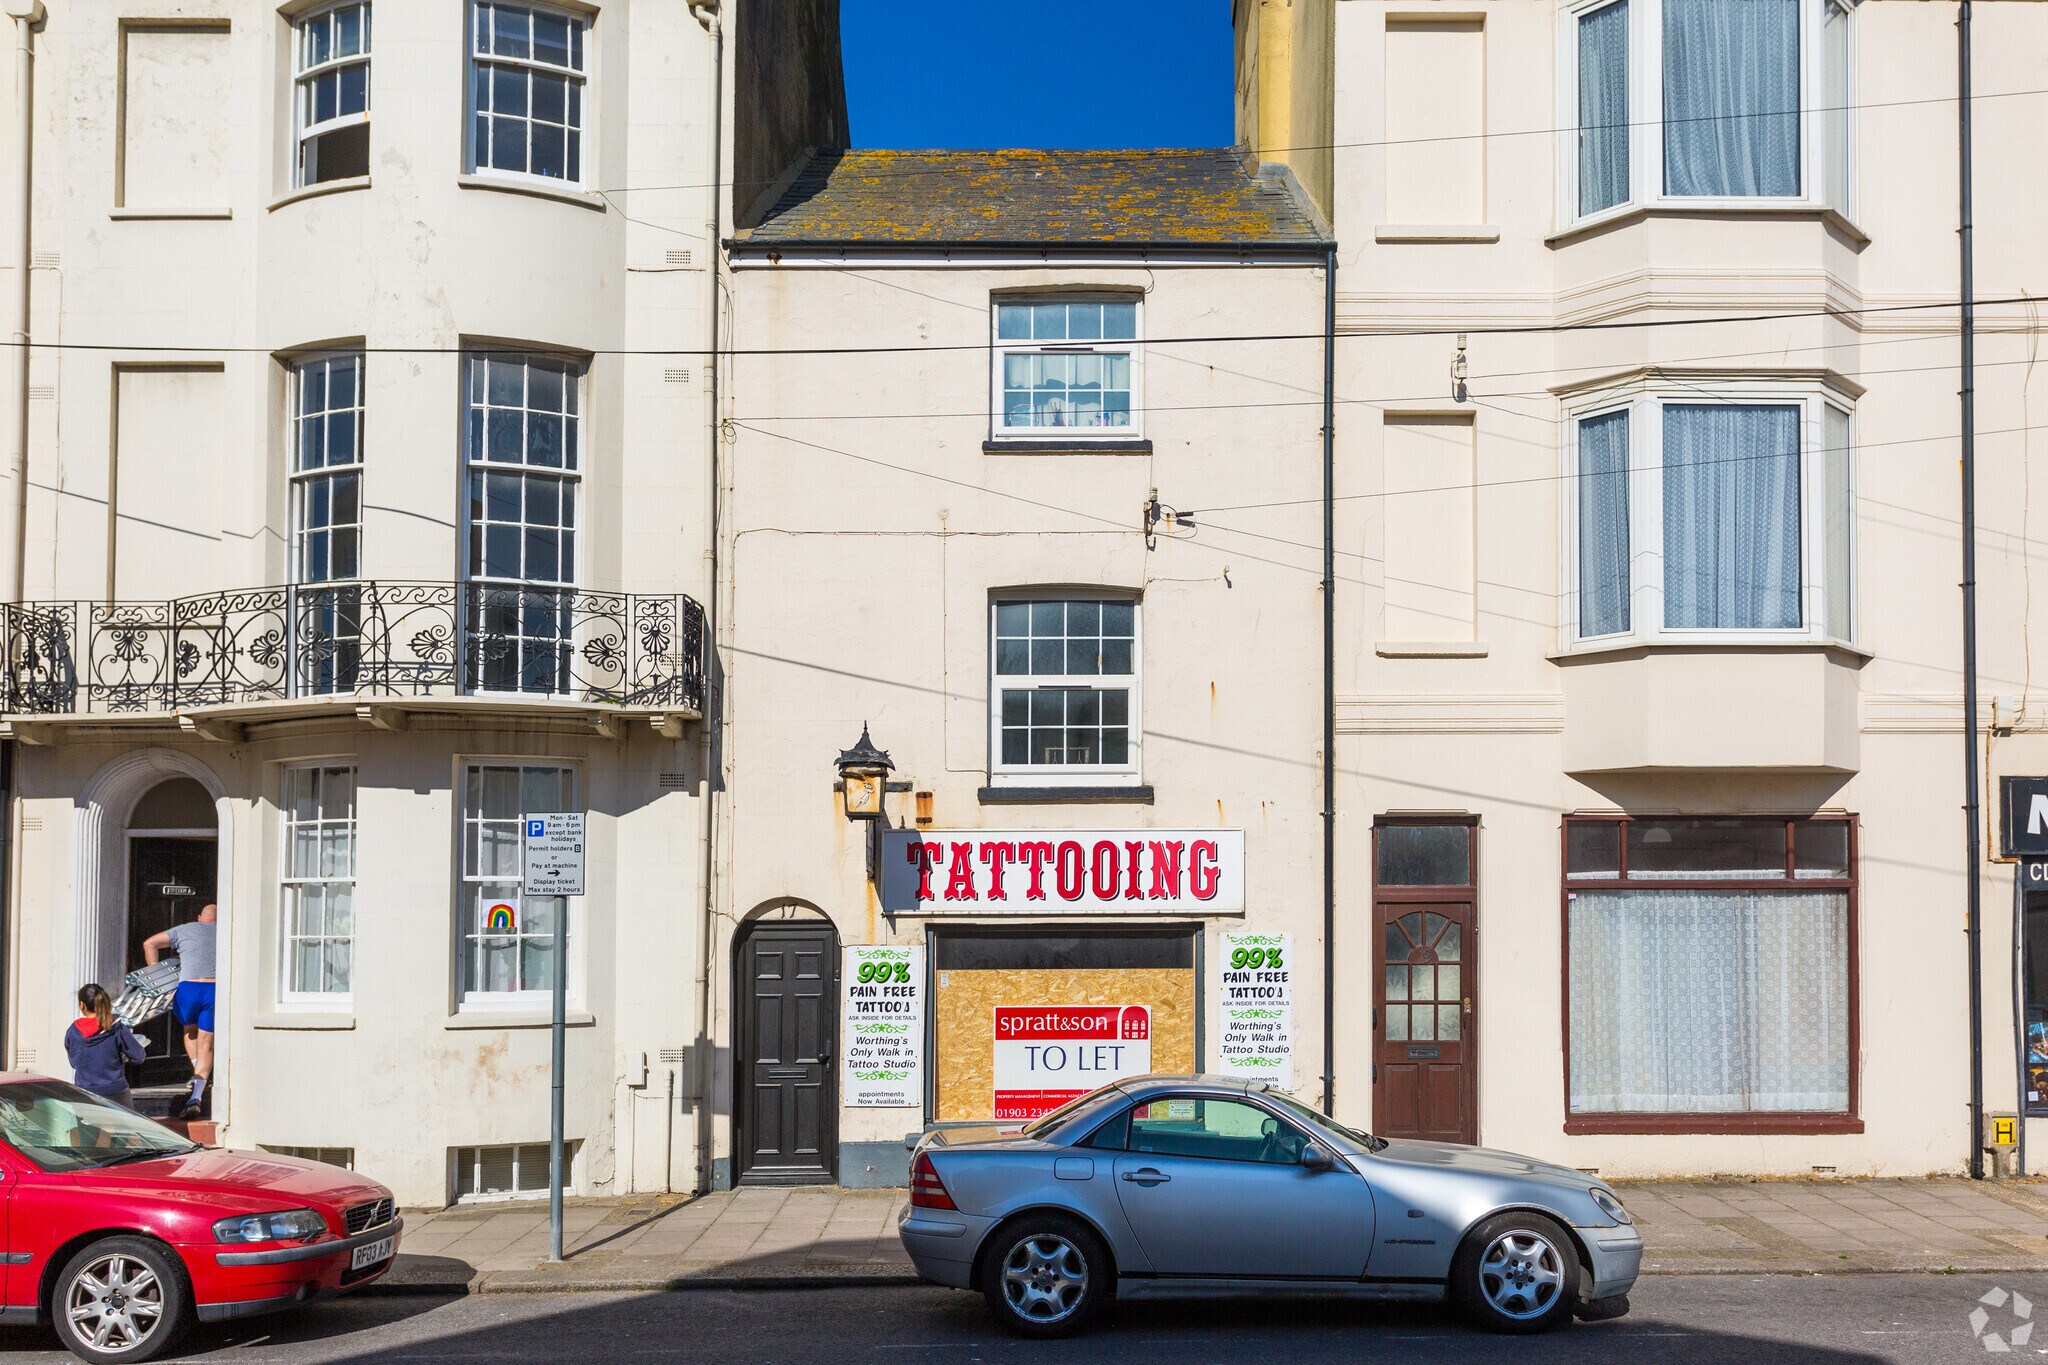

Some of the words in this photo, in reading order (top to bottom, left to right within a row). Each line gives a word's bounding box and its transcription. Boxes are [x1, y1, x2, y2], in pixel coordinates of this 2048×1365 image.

[531, 822, 542, 836] P
[906, 839, 1221, 901] TATTOOING
[1230, 947, 1284, 970] 99%
[856, 961, 910, 984] 99%
[1223, 972, 1250, 983] PAIN
[1256, 972, 1289, 983] FREE
[850, 986, 877, 997] PAIN
[883, 986, 916, 997] FREE
[1000, 1013, 1108, 1036] spratt&son
[1230, 1022, 1282, 1032] Worthing's
[856, 1036, 908, 1047] Worthing's
[1224, 1033, 1247, 1043] Only
[1251, 1033, 1274, 1042] Walk
[1278, 1033, 1287, 1042] in
[850, 1048, 873, 1058] Only
[877, 1047, 900, 1056] Walk
[904, 1047, 914, 1056] in
[1222, 1045, 1253, 1054] Tattoo
[1257, 1045, 1290, 1054] Studio
[848, 1059, 879, 1069] Tattoo
[883, 1059, 916, 1069] Studio
[1024, 1046, 1067, 1071] TO
[1078, 1046, 1125, 1071] LET
[996, 1108, 1027, 1117] 01903
[1996, 1122, 2012, 1143] H
[355, 1244, 377, 1266] RF03
[377, 1238, 392, 1258] AJY
